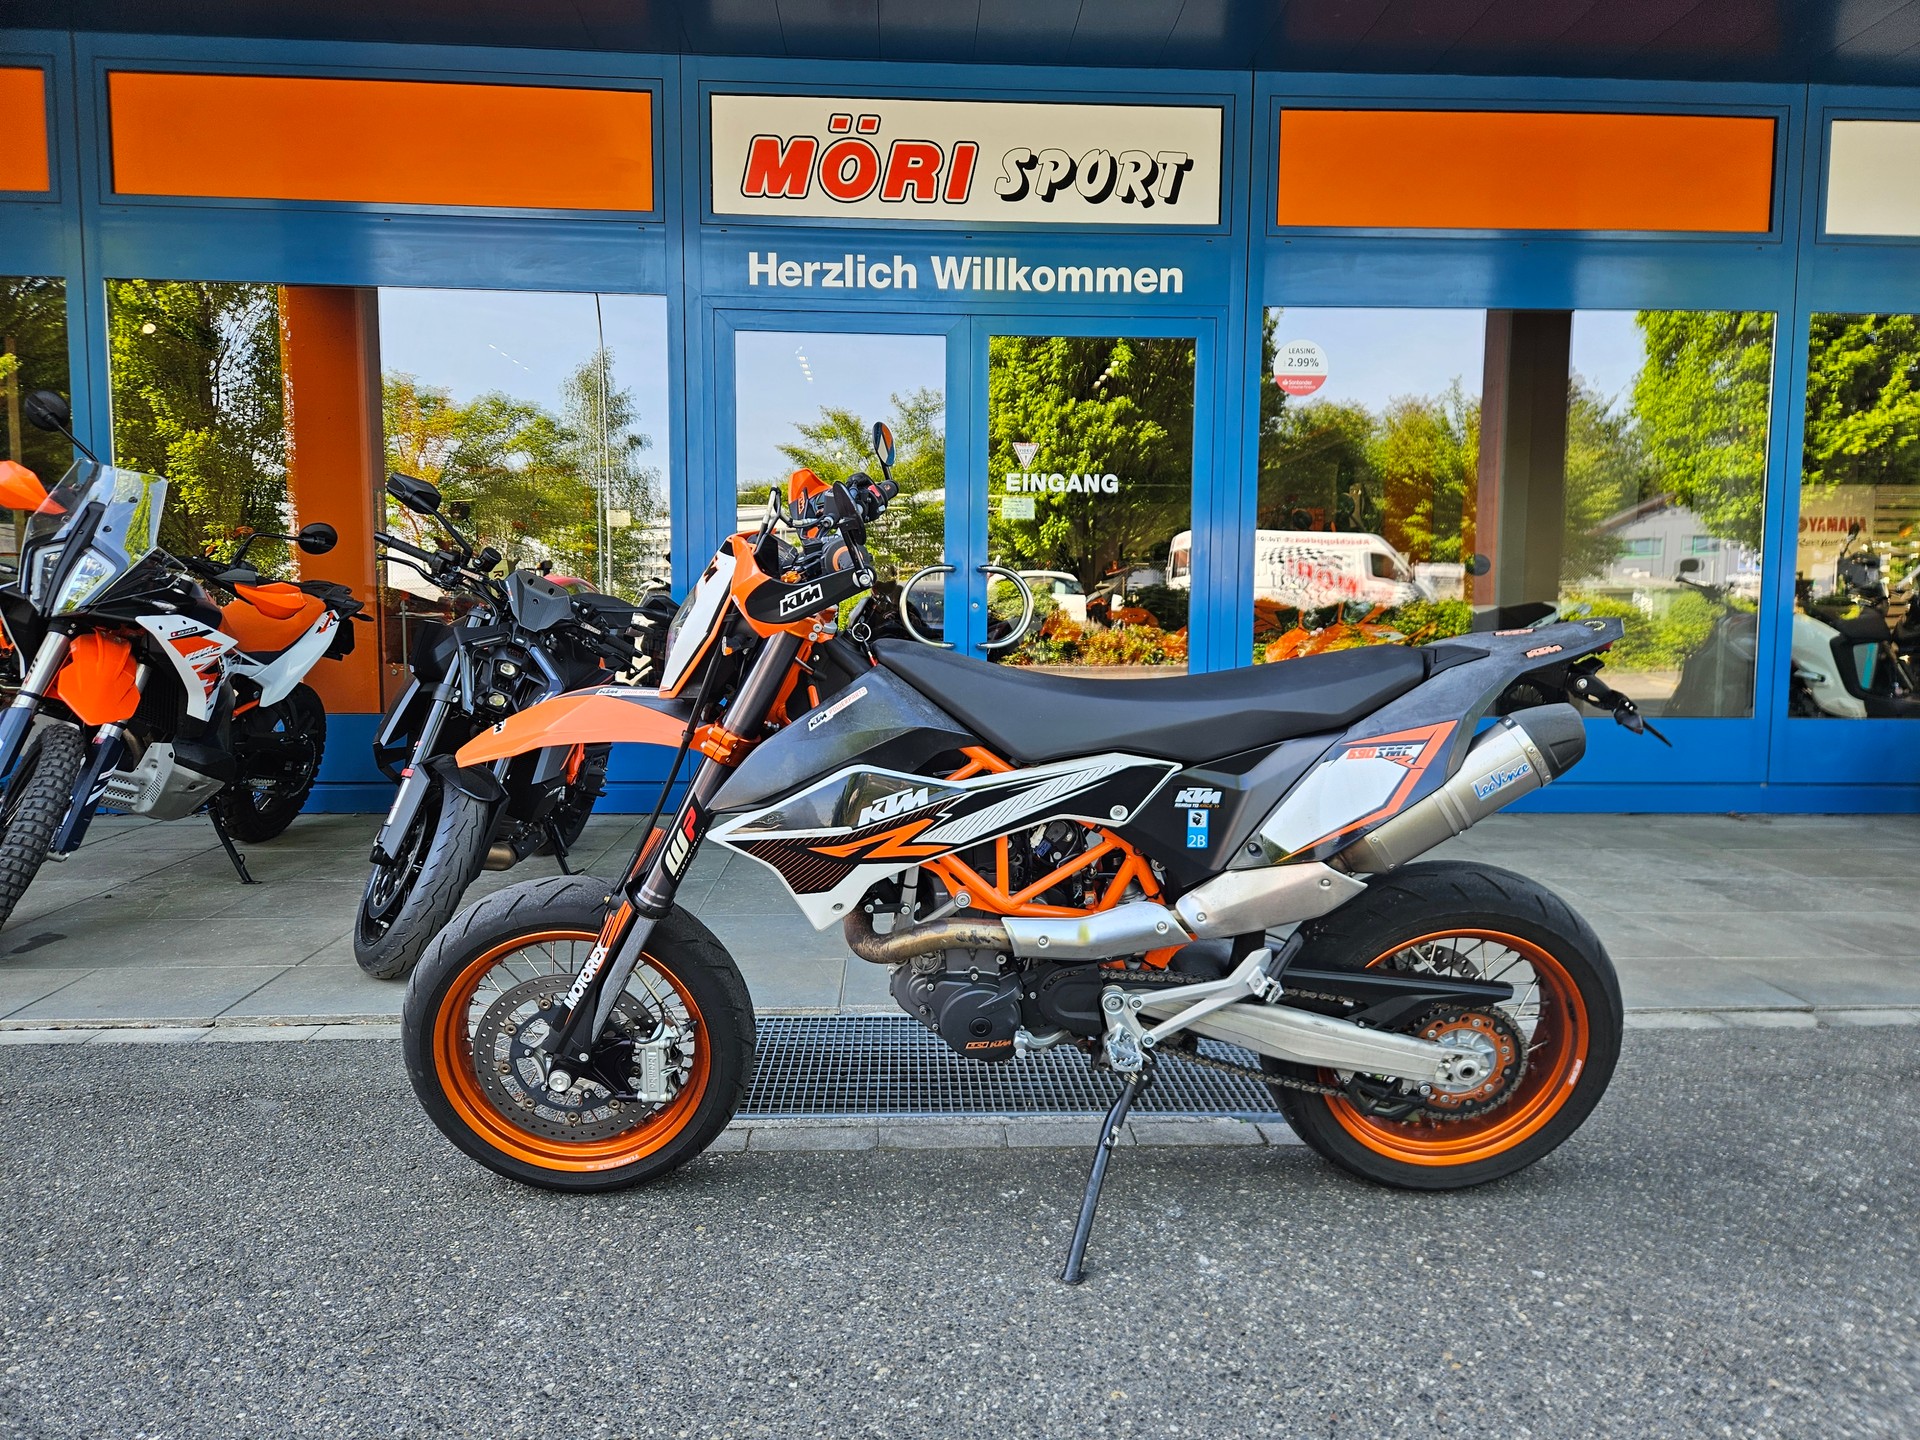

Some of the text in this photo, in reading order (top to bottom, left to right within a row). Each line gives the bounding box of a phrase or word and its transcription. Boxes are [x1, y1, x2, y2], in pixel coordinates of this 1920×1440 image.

[740, 113, 1194, 208] MÖRI SPORT
[748, 251, 1184, 294] Herzlich Willkommen
[1287, 357, 1320, 367] 2.99%
[1288, 347, 1316, 355] LEASING
[1006, 472, 1119, 494] EINGANG
[781, 584, 822, 615] KTM
[810, 688, 867, 728] KTM POWERPARTS
[1174, 787, 1222, 804] KTM
[1474, 762, 1530, 799] LeoVince
[857, 786, 929, 827] KTM
[1188, 834, 1206, 847] 2B
[564, 942, 609, 1012] MOTOREX
